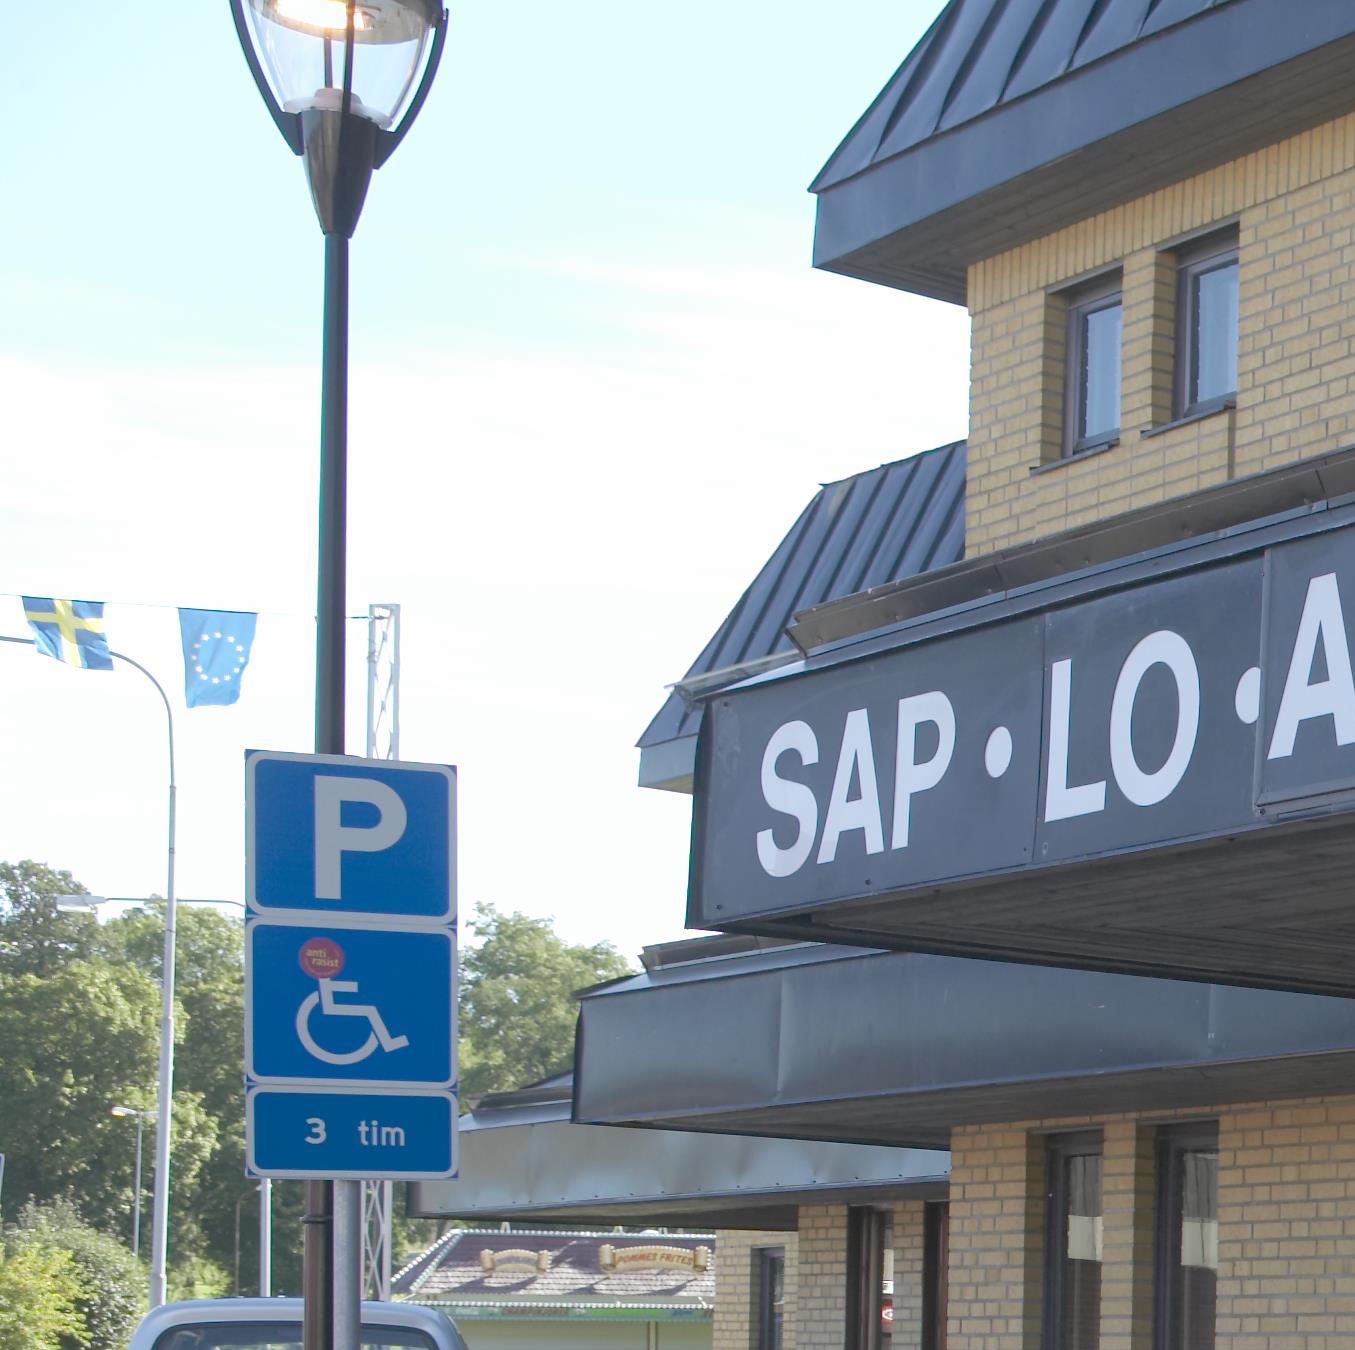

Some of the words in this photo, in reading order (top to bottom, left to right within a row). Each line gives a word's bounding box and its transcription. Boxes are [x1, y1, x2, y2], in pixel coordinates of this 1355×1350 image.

[757, 690, 957, 878] SAP
[1043, 629, 1201, 822] LO
[313, 775, 407, 899] P
[304, 1118, 327, 1144] 3
[358, 1117, 405, 1147] tim
